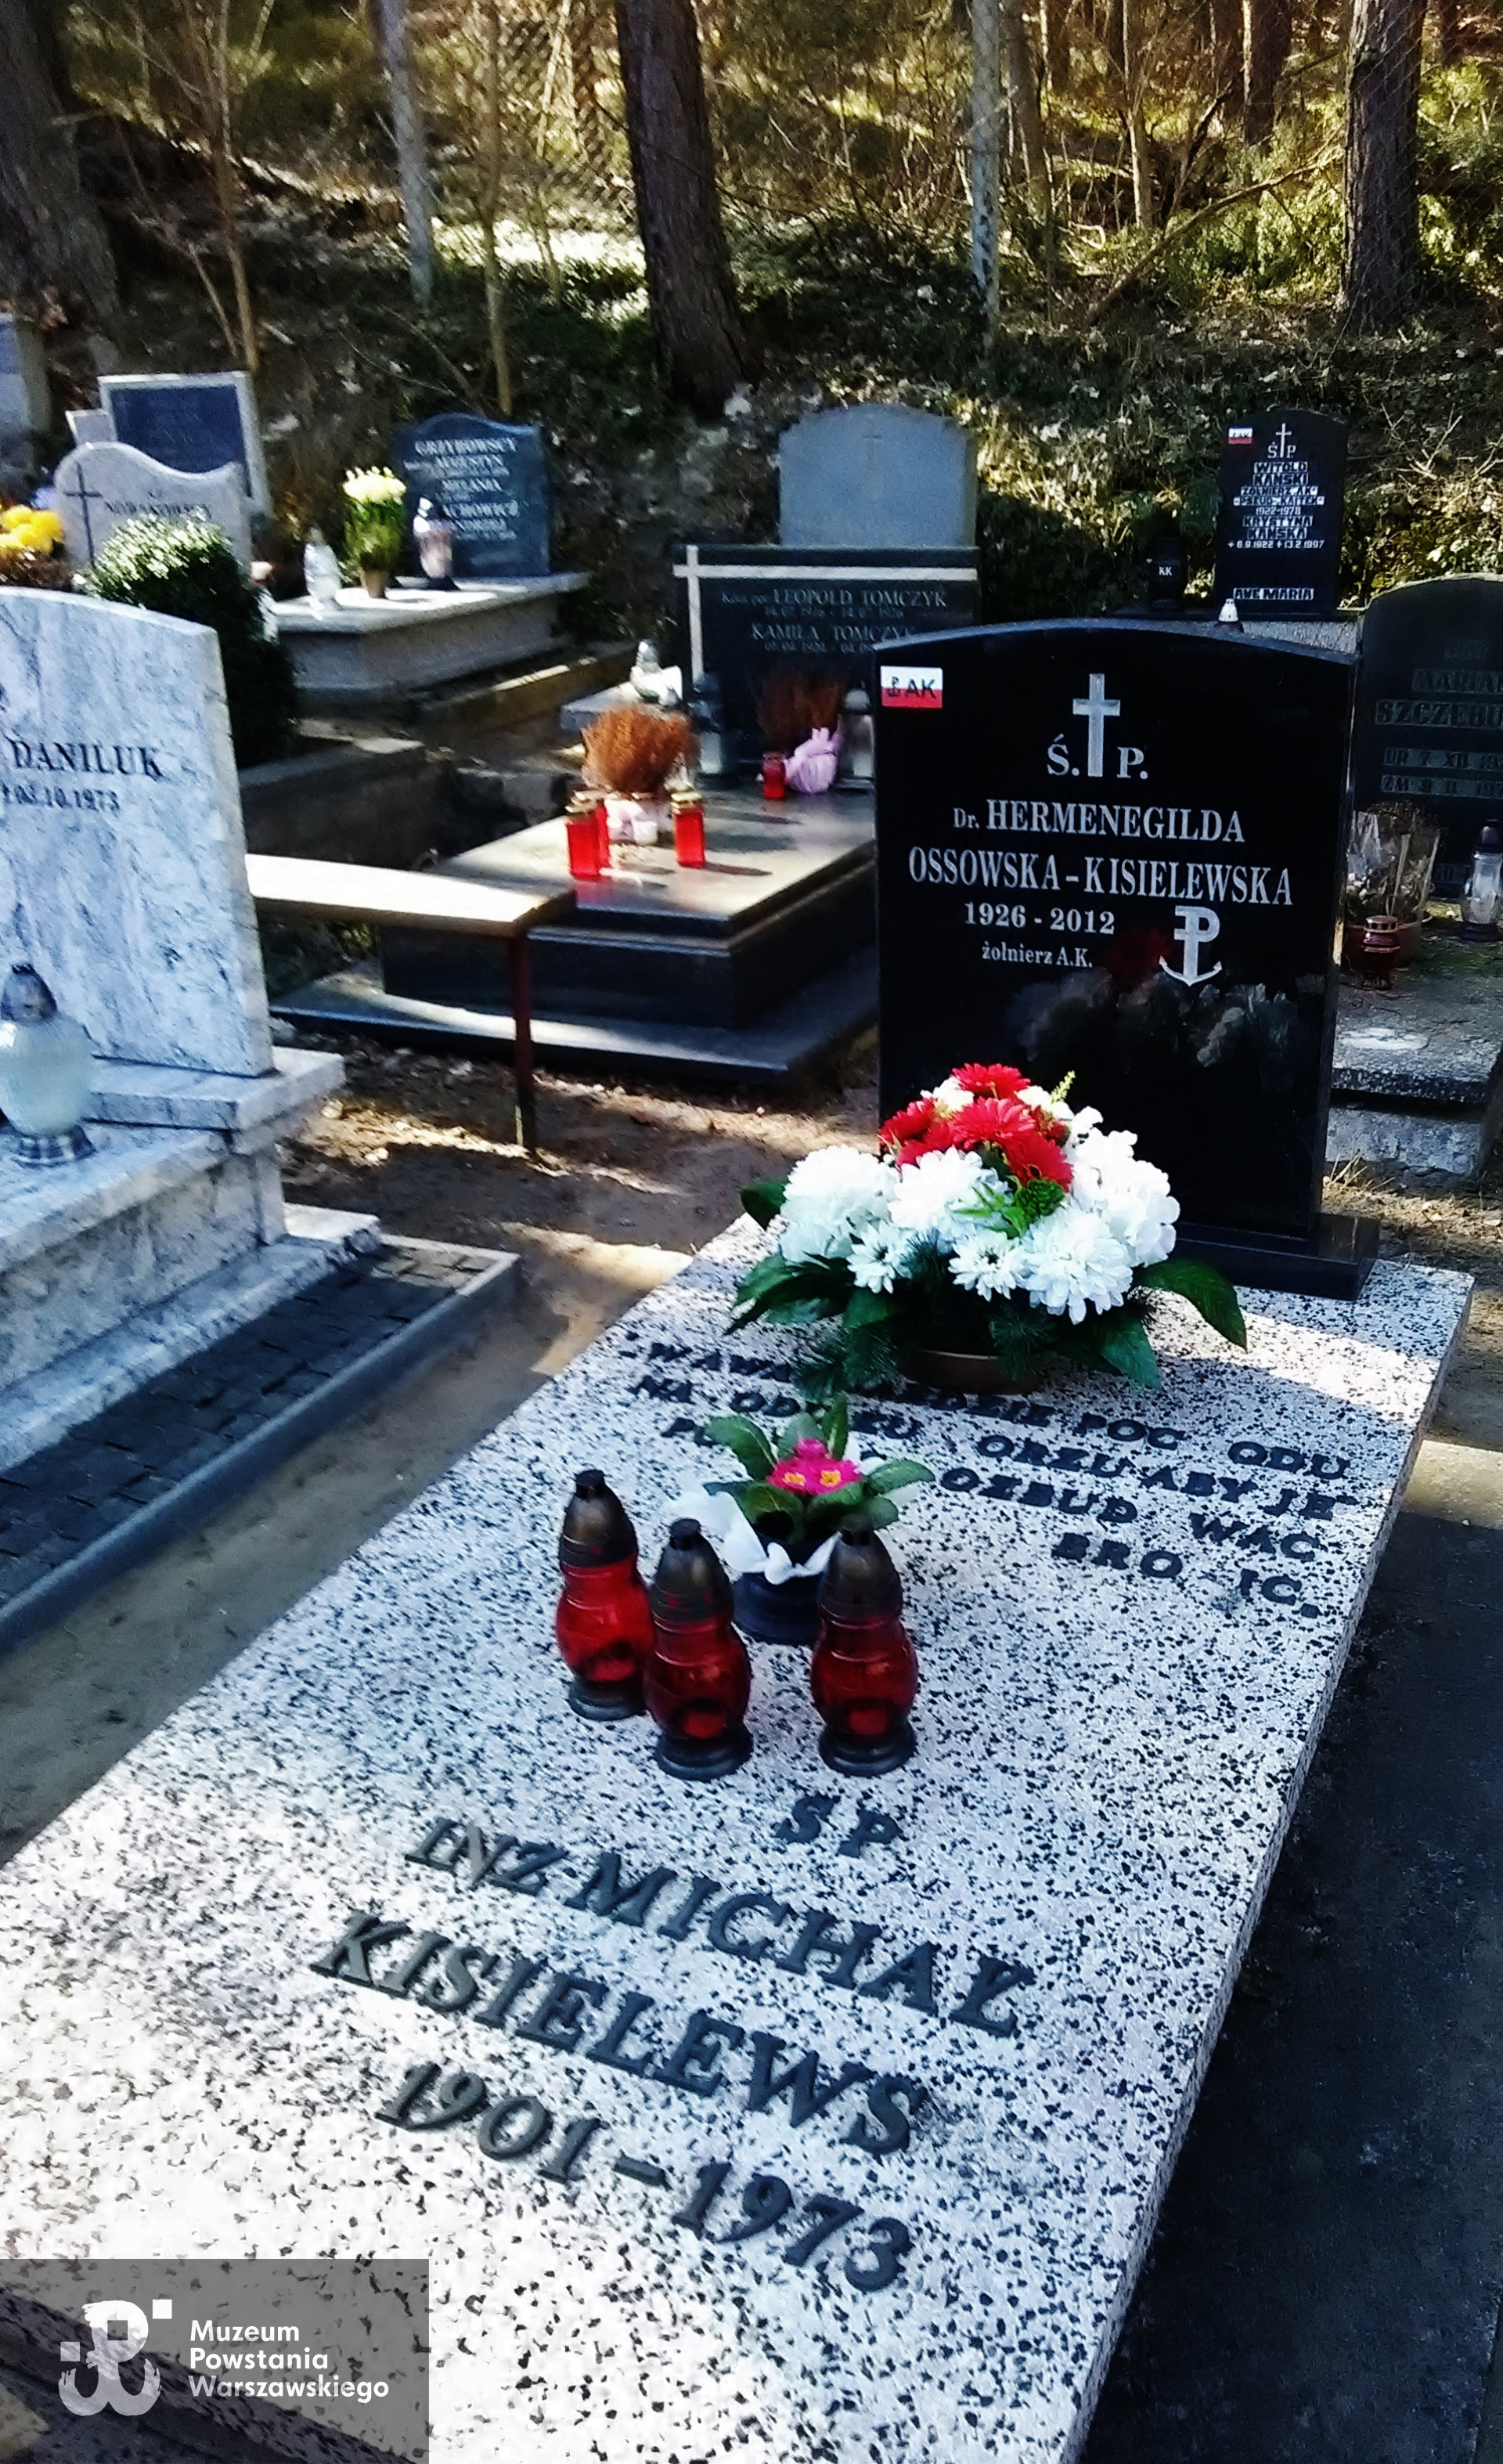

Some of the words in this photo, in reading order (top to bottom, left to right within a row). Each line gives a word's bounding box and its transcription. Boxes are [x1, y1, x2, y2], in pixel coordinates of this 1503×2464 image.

[1254, 461, 1308, 474] WITOLD
[862, 589, 949, 608] TOMCZYK
[1234, 587, 1260, 600] AVE
[1263, 587, 1314, 600] MARIA
[905, 678, 937, 700] AK
[9, 740, 164, 781] DANILUK
[1046, 733, 1080, 776] Ś.
[1116, 746, 1148, 780] P.
[953, 807, 980, 829] Dr.
[986, 799, 1246, 842] HERMENEGILDA
[964, 902, 1026, 929] 1926
[1050, 907, 1116, 936] 2012
[310, 1908, 932, 2159] KISIELEWS
[374, 2062, 607, 2186] 1901
[669, 2159, 916, 2293] 1973
